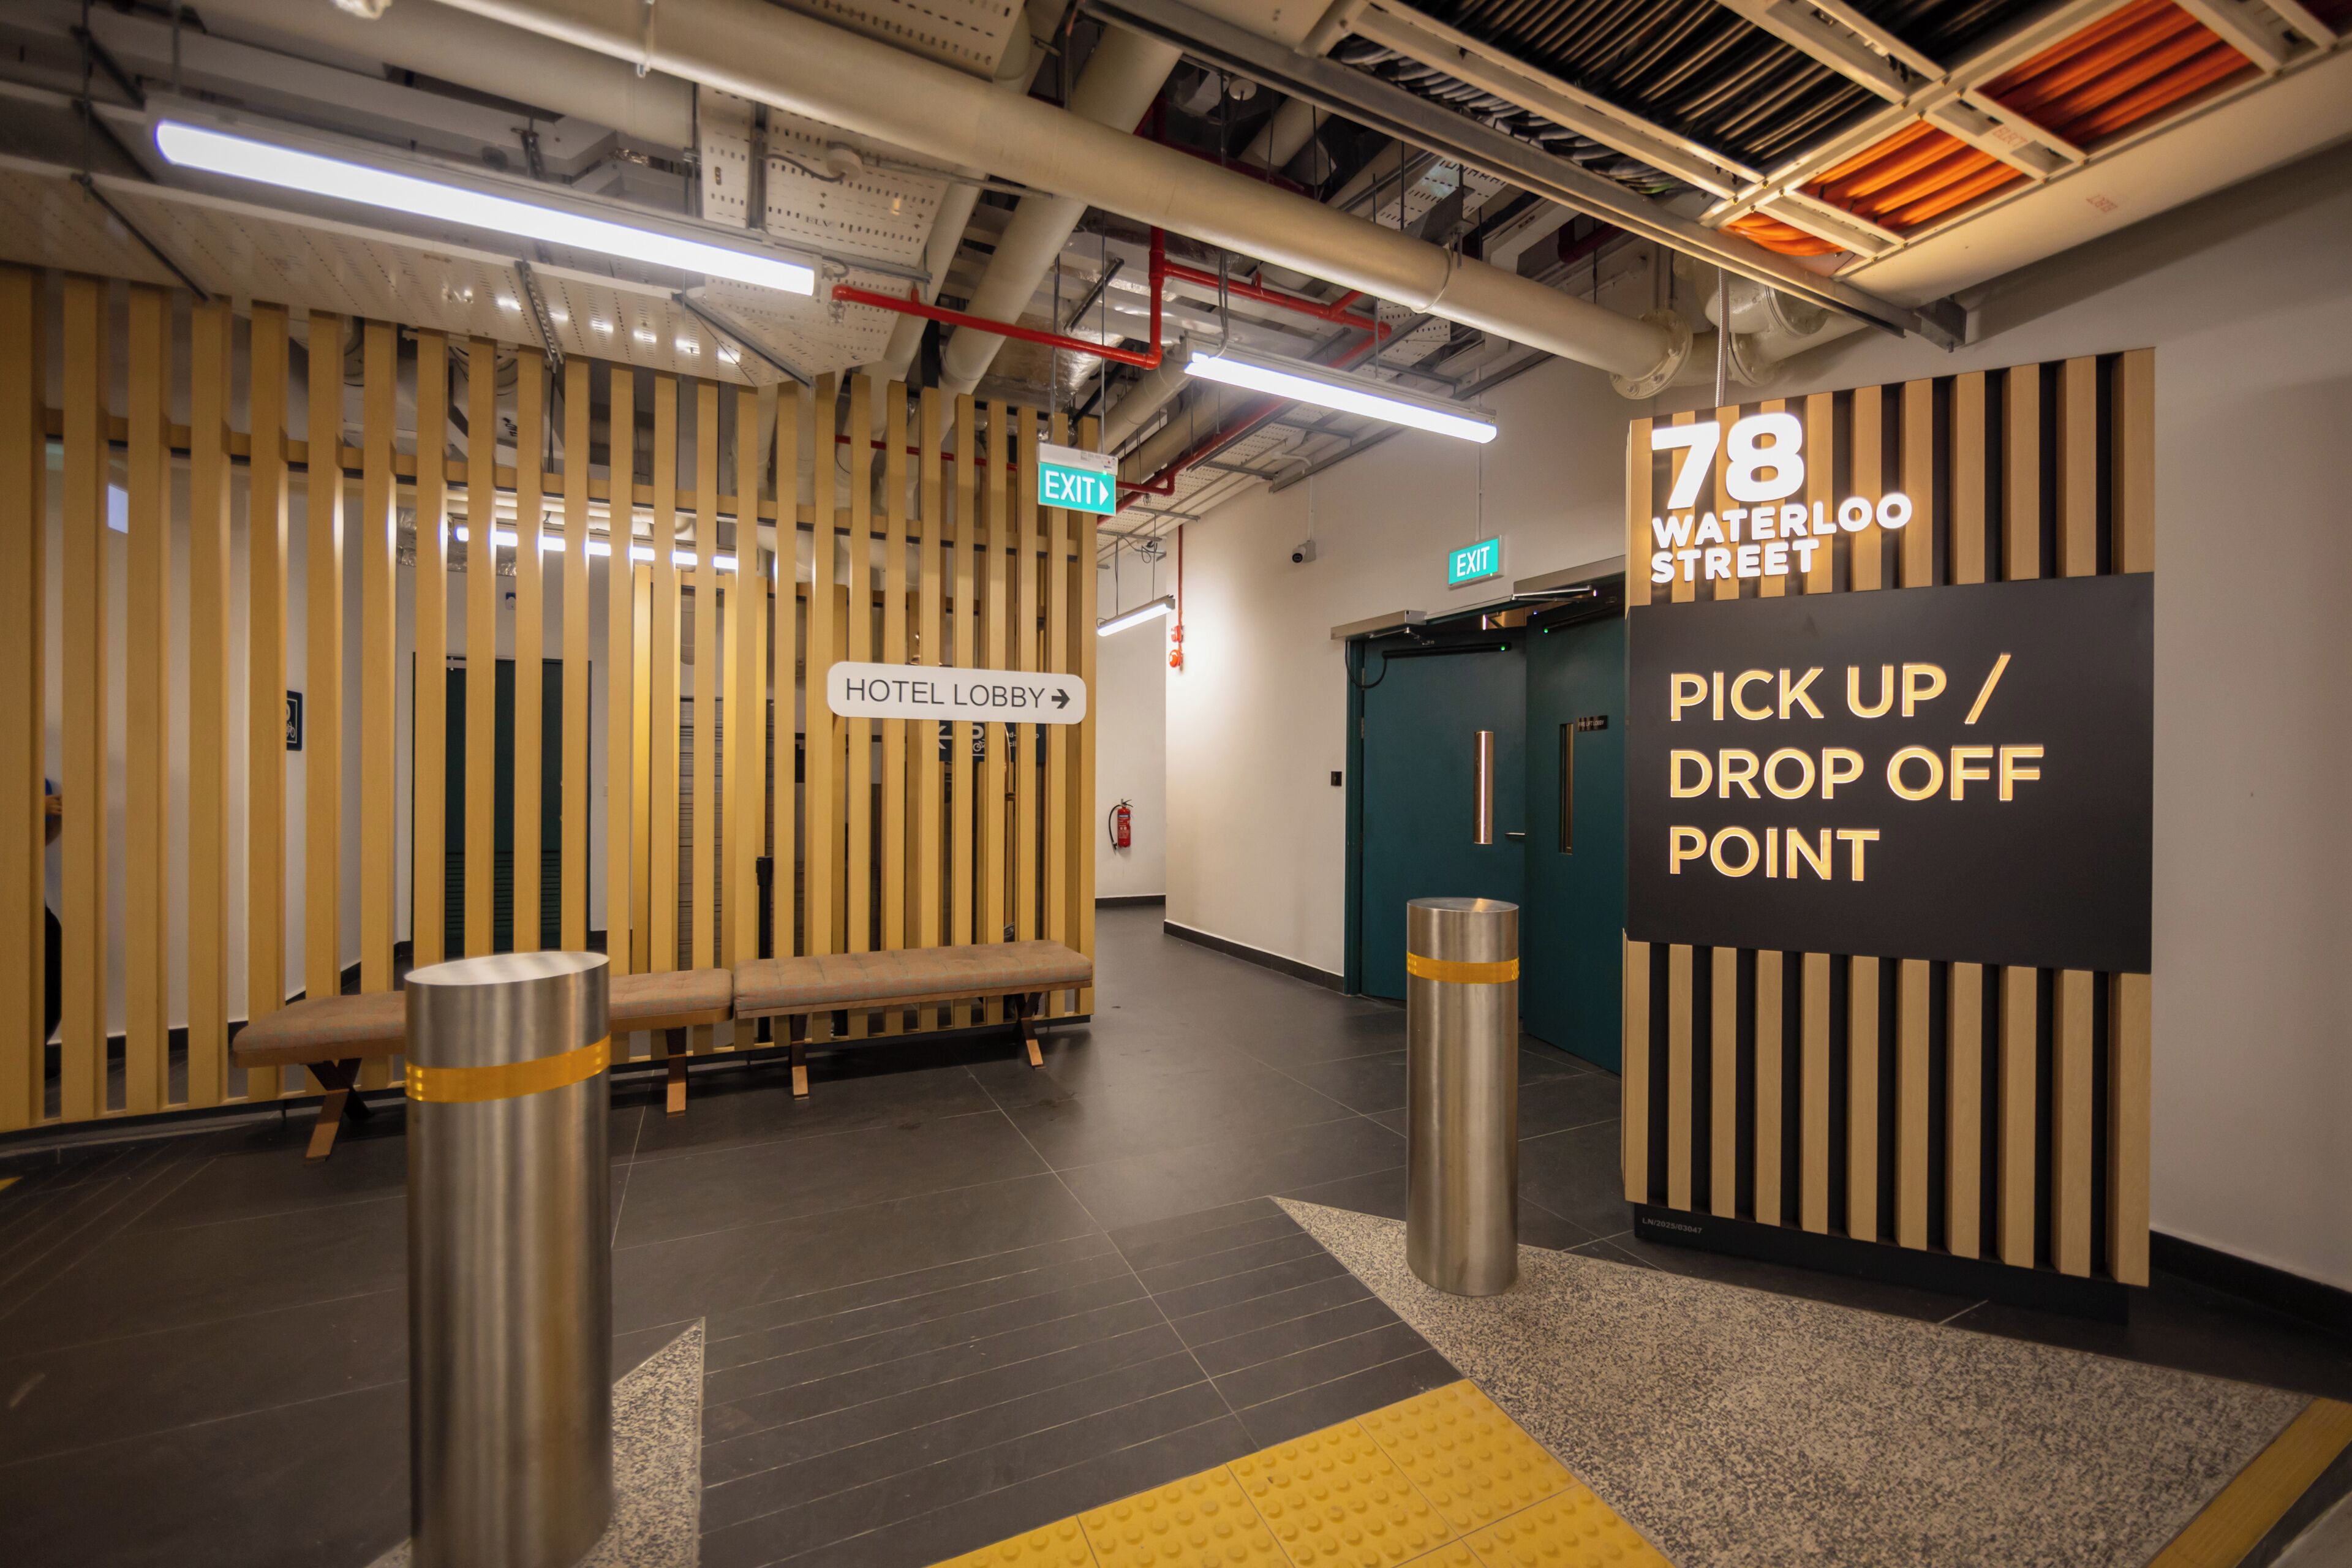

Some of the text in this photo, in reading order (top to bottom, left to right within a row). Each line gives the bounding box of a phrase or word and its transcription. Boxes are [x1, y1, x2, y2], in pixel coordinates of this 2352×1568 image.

[1651, 412, 1804, 510] 78
[1045, 470, 1095, 505] EXIT
[1651, 493, 1912, 548] WATERLOO
[1457, 546, 1490, 578] EXIT
[1651, 540, 1819, 584] STREET
[846, 678, 1045, 709] HOTEL LOBBY
[1670, 652, 2011, 725] PICK UP /
[1670, 744, 2045, 802] DROP OFF
[1670, 826, 1880, 881] POINT
[1642, 1217, 1702, 1234] LN/2025/03047
